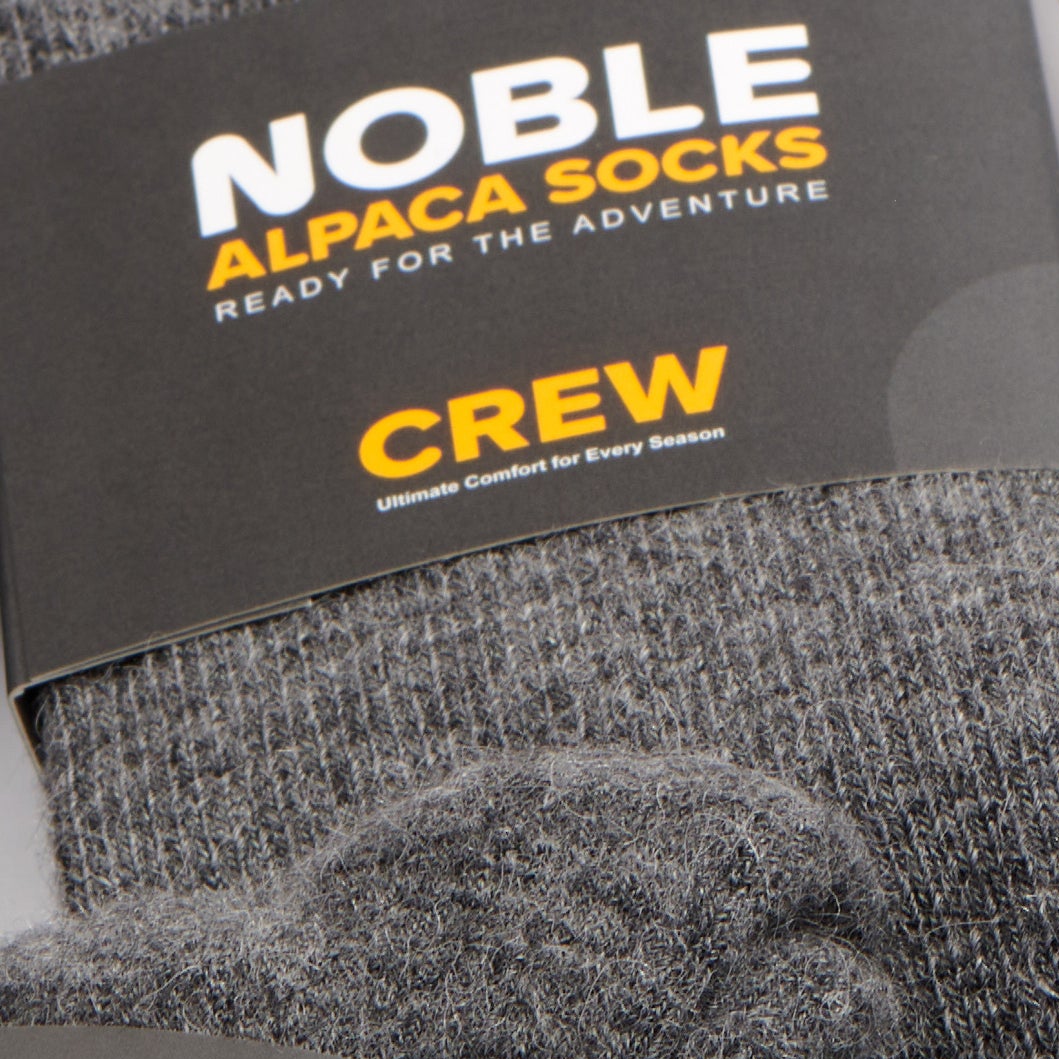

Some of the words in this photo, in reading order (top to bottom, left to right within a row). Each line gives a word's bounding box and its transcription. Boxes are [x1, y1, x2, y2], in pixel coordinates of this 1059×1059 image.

[192, 24, 819, 237] NOBLE
[206, 174, 527, 291] ALPACA
[543, 126, 828, 205] SOCKS
[215, 268, 348, 322] READY
[371, 243, 453, 279] FOR
[473, 221, 551, 254] THE
[573, 179, 829, 236] ADVENTURE
[358, 345, 729, 480] CREW
[376, 479, 460, 512] Ultimate
[464, 459, 548, 490] Comfort
[550, 452, 581, 471] for
[585, 441, 644, 464] Every
[649, 427, 726, 450] Season
